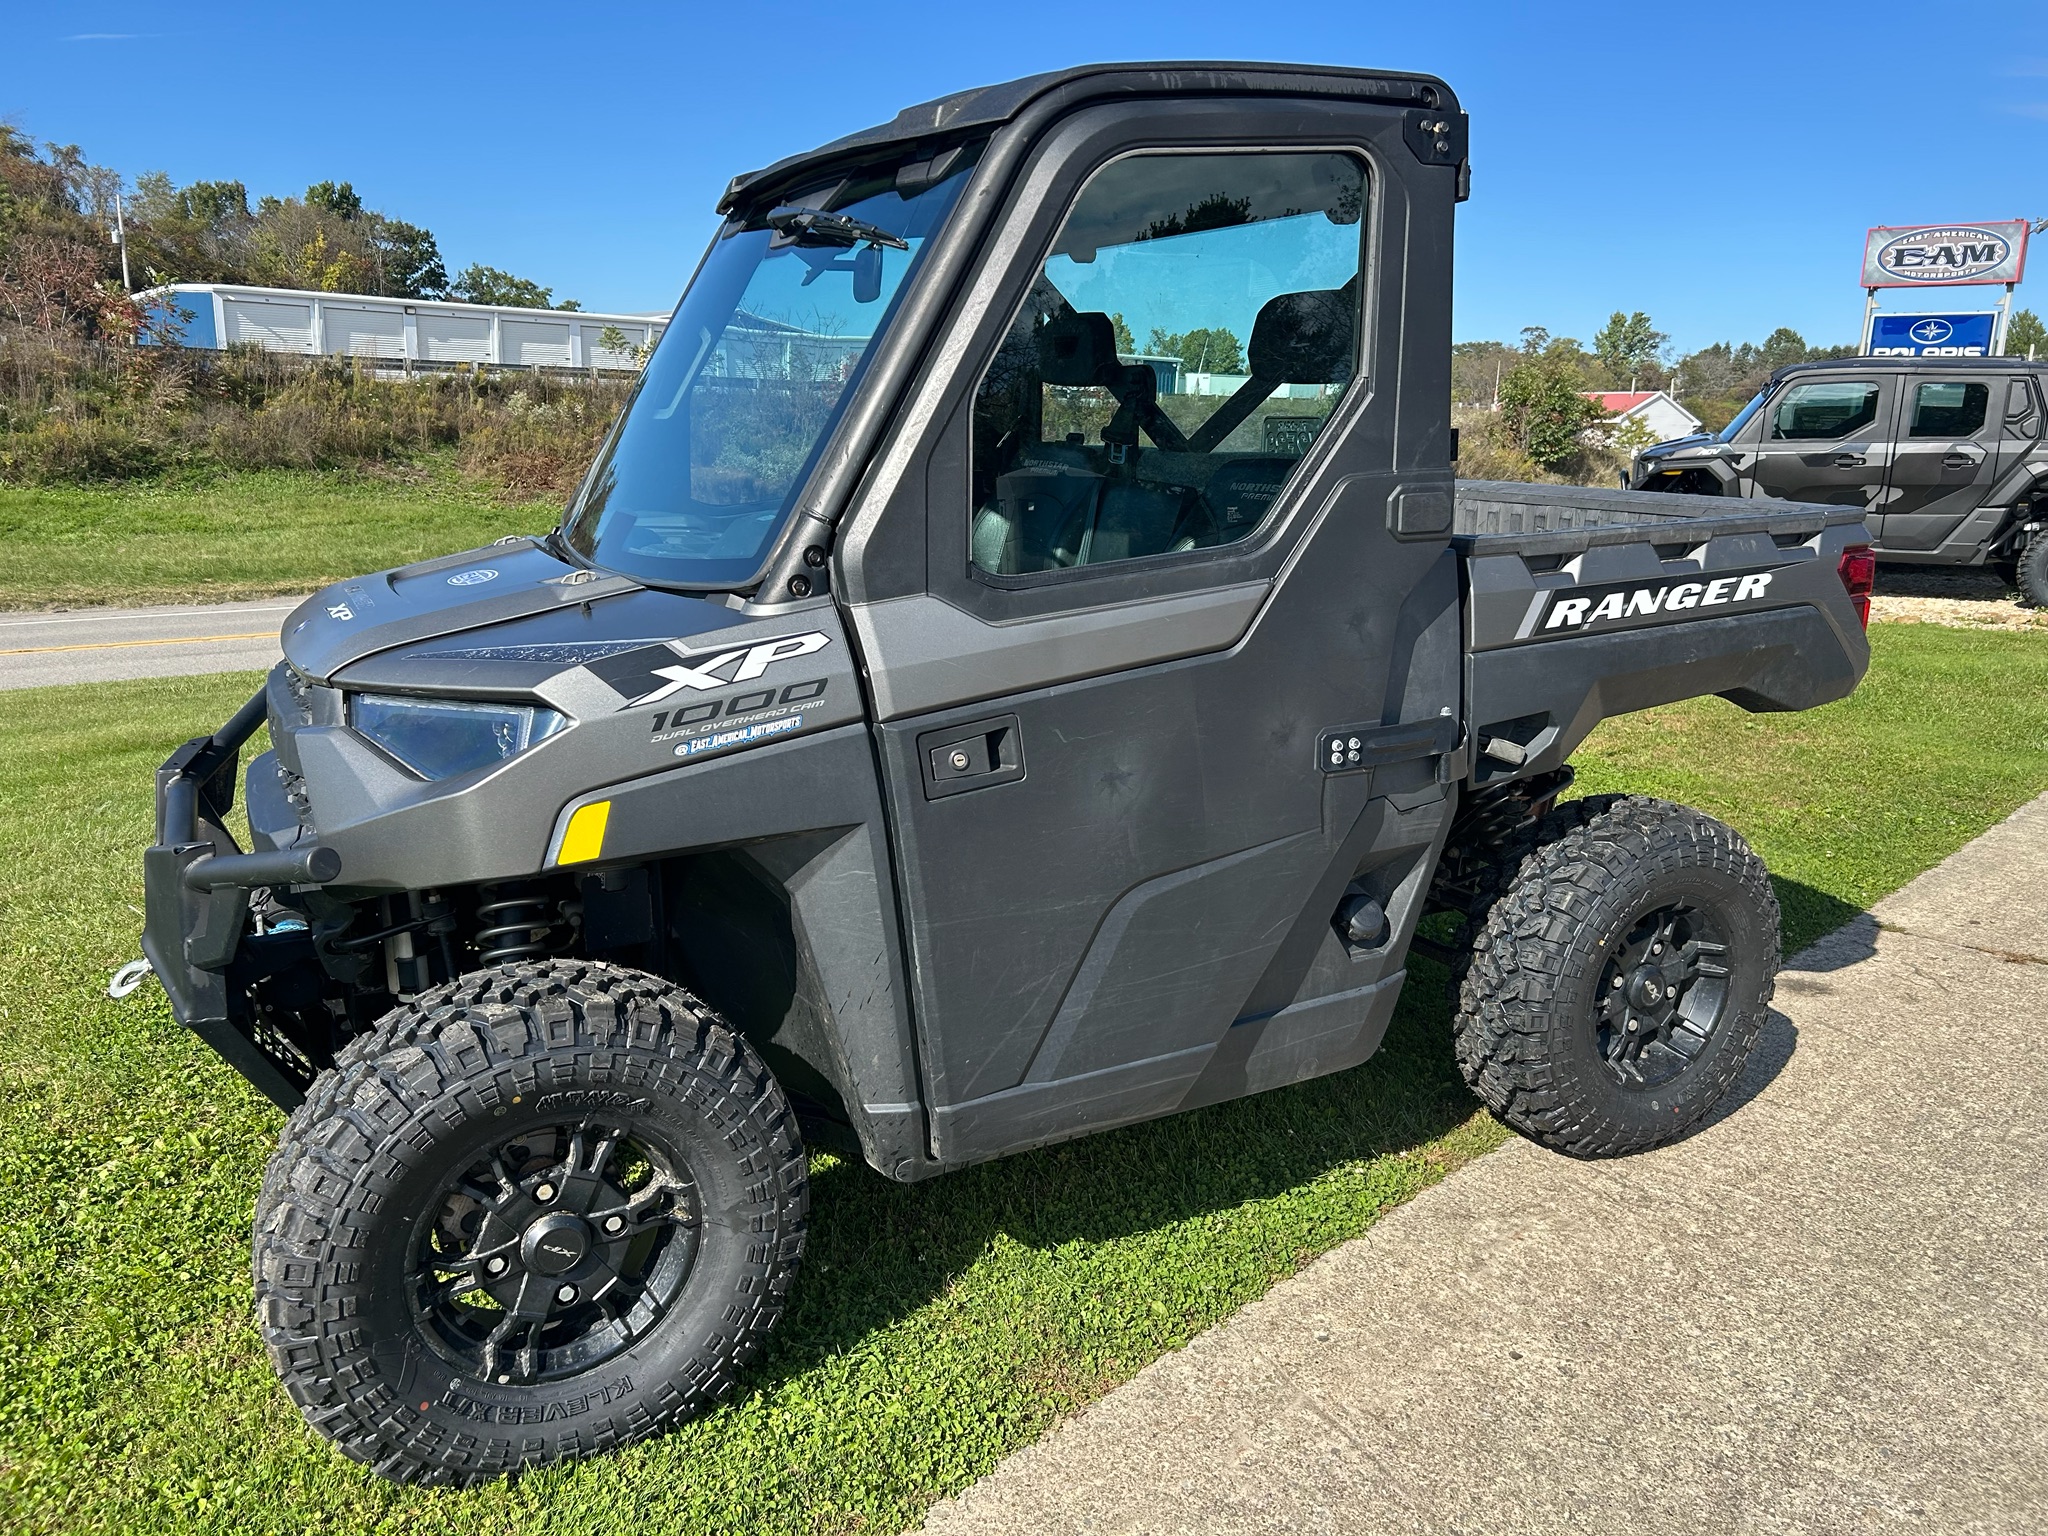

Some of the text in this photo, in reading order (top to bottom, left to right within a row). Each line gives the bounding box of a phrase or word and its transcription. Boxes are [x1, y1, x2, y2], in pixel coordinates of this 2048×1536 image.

[1902, 230, 1990, 245] EAST AMERICAN
[1887, 242, 2002, 270] EAM
[1902, 267, 1978, 278] MOTORSPORTS
[1229, 482, 1283, 493] NORTHS
[326, 602, 354, 621] XP
[1544, 572, 1772, 630] RANGER
[616, 630, 833, 712] XP
[650, 699, 826, 743] DUAL OVERHEAD CAM
[651, 677, 829, 733] 1000
[495, 1374, 633, 1425] KLEVER
